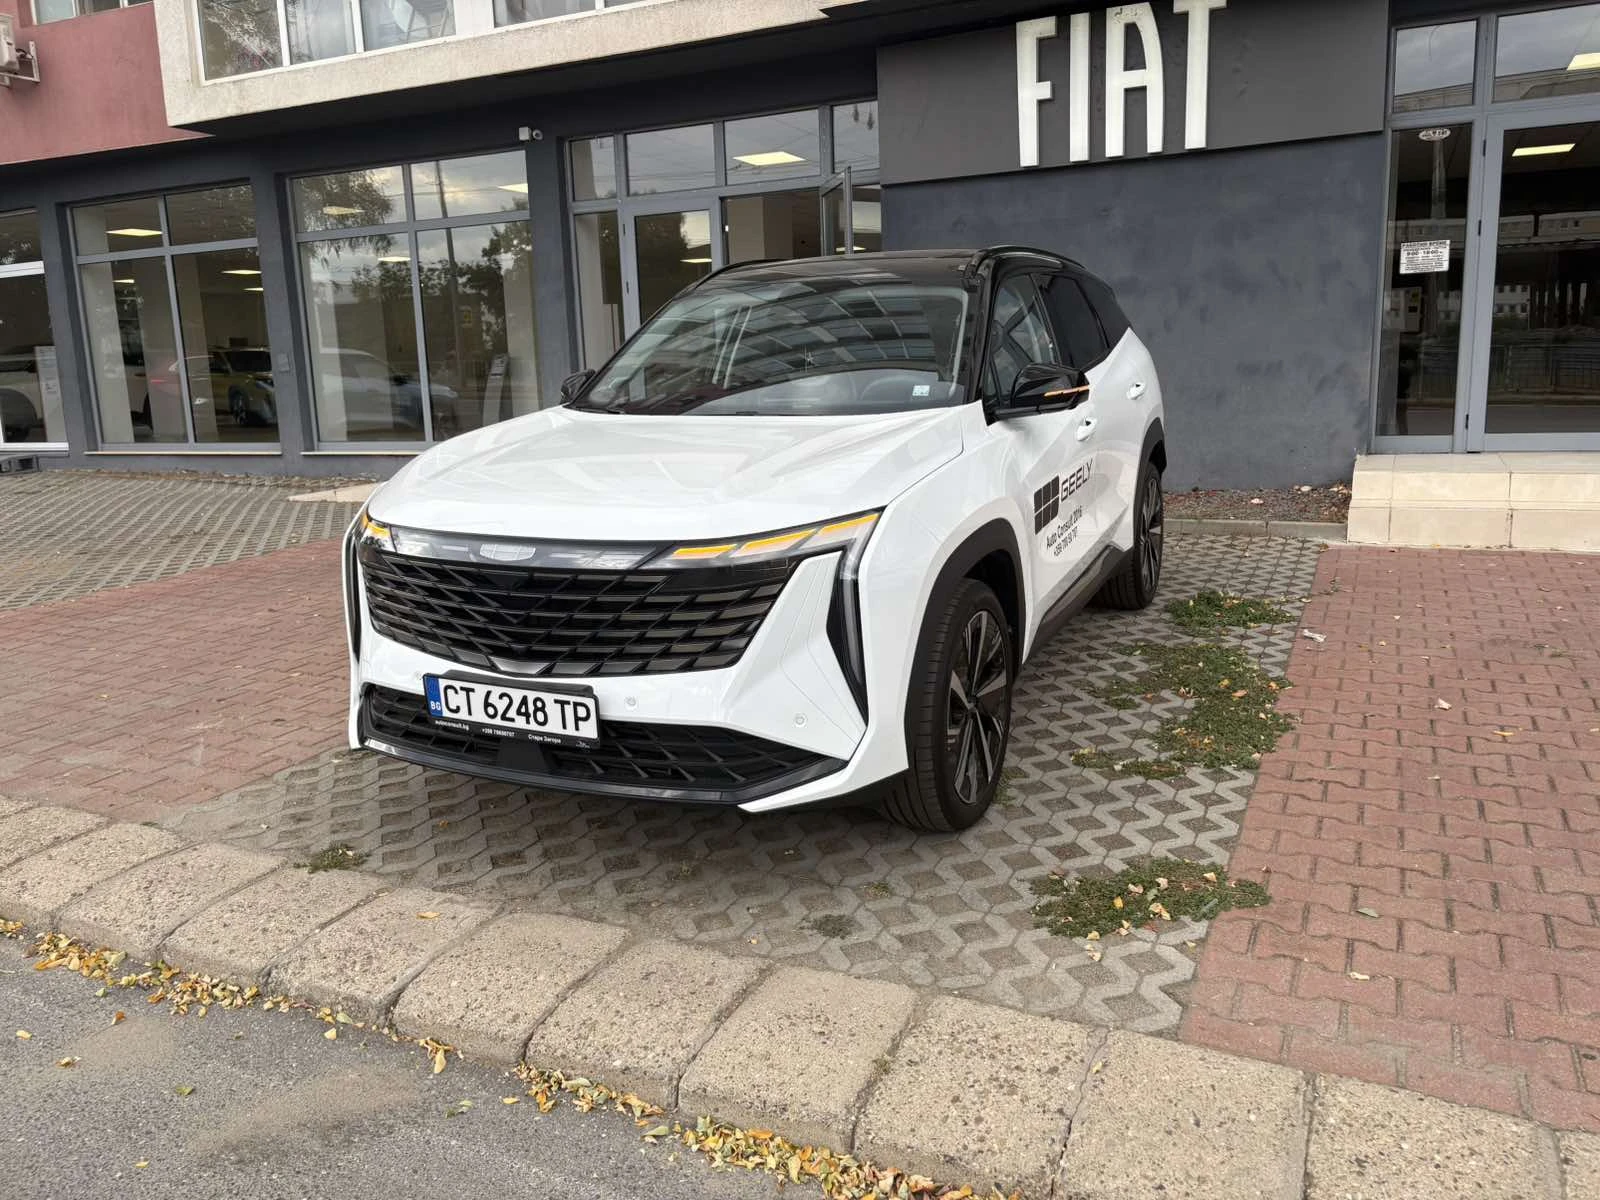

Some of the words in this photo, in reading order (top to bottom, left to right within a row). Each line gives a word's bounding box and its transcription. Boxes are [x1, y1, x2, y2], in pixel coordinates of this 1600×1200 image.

[1016, 0, 1228, 167] FIAT
[1061, 458, 1093, 502] GEELY
[1046, 532, 1057, 550] Auto
[430, 701, 441, 711] BG
[443, 684, 475, 716] CT
[483, 690, 548, 727] 6248
[554, 699, 591, 731] TP
